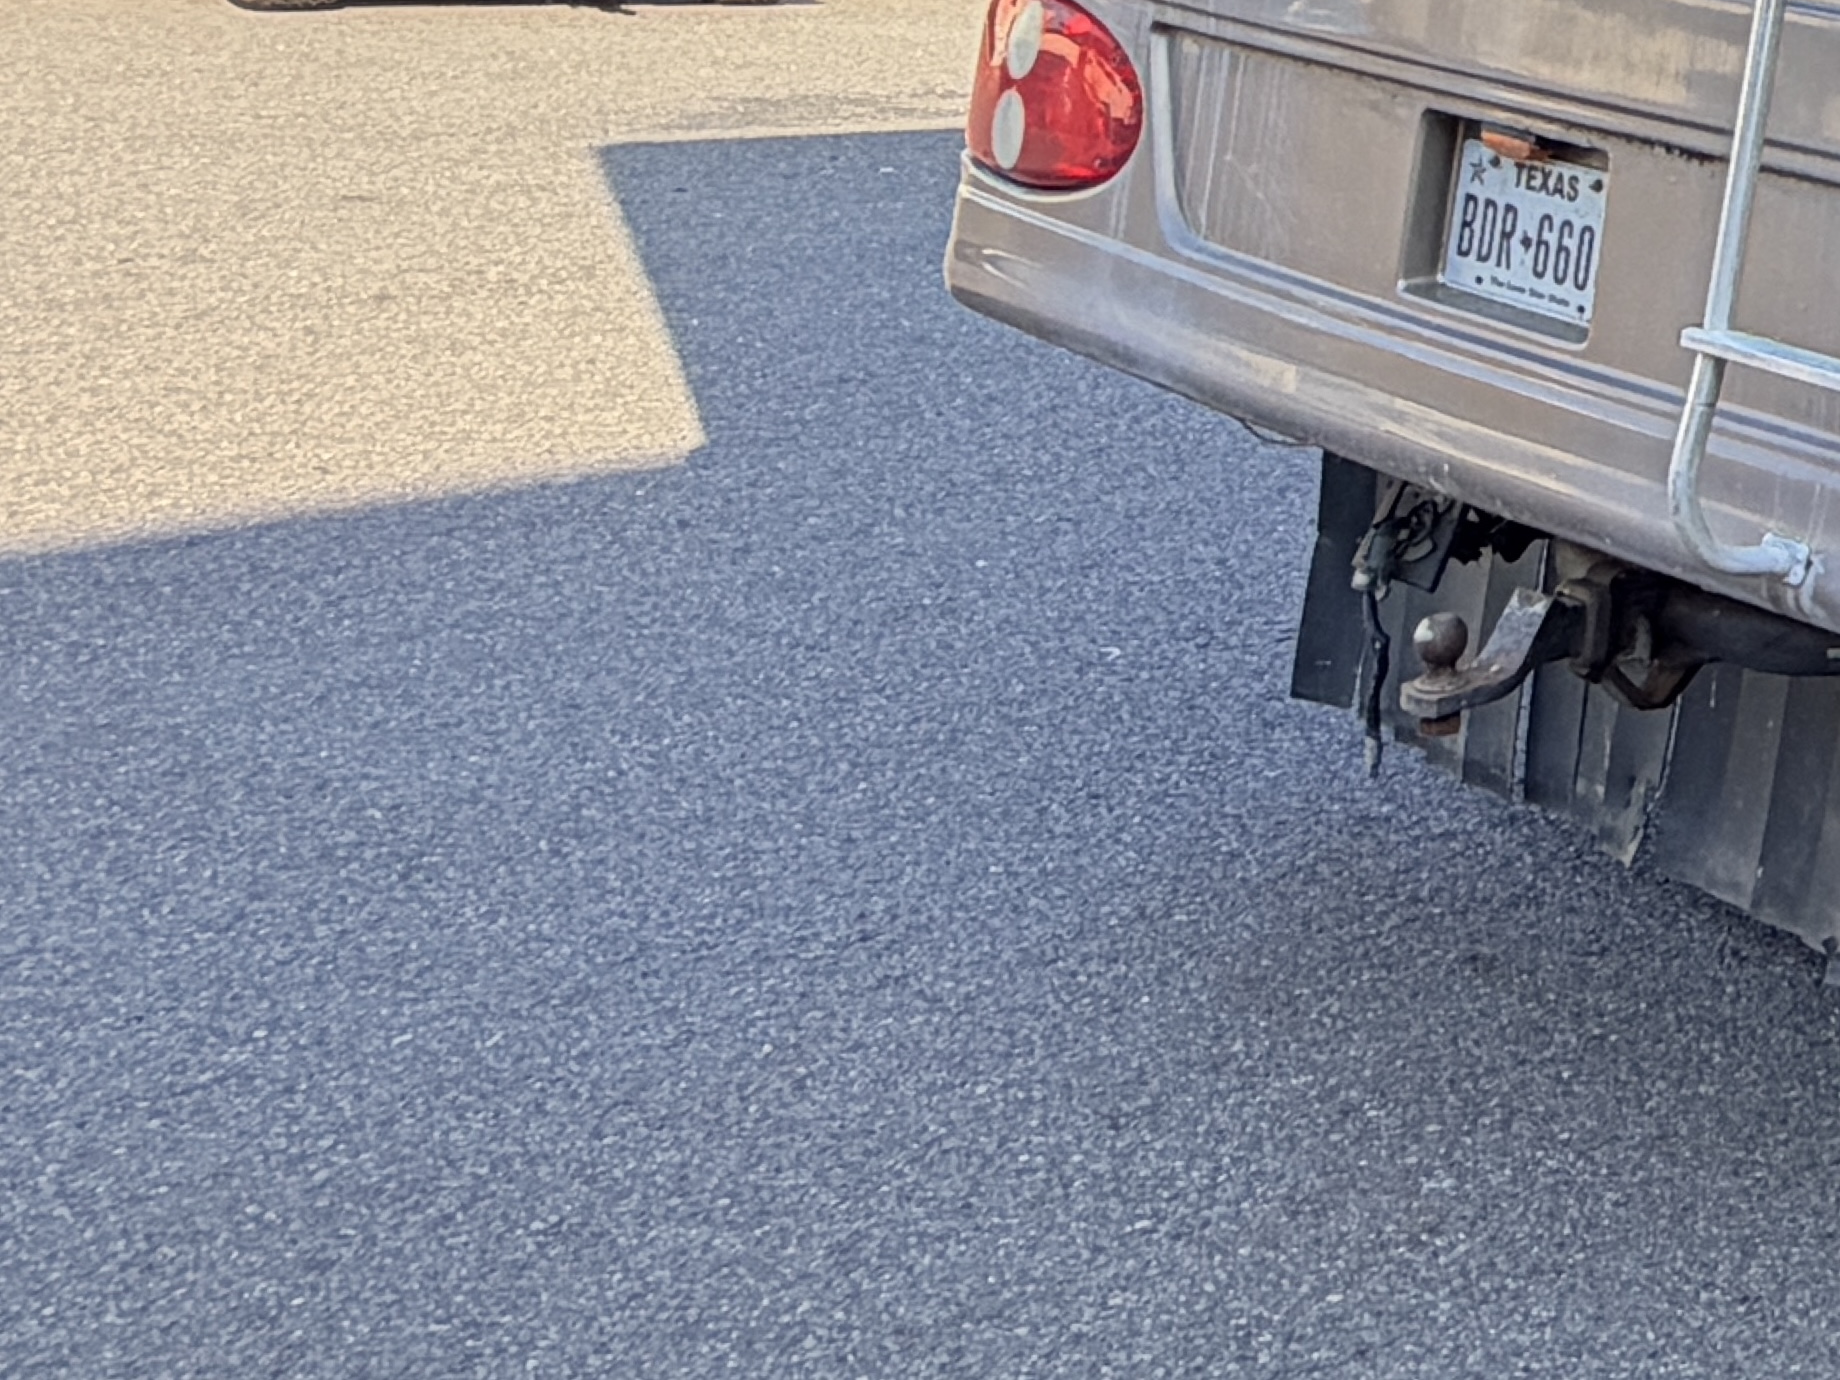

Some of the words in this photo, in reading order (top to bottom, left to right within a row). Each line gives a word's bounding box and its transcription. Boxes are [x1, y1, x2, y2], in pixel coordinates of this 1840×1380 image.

[1513, 162, 1580, 203] TEXAS
[1456, 192, 1519, 271] BDR
[1531, 213, 1595, 291] 660
